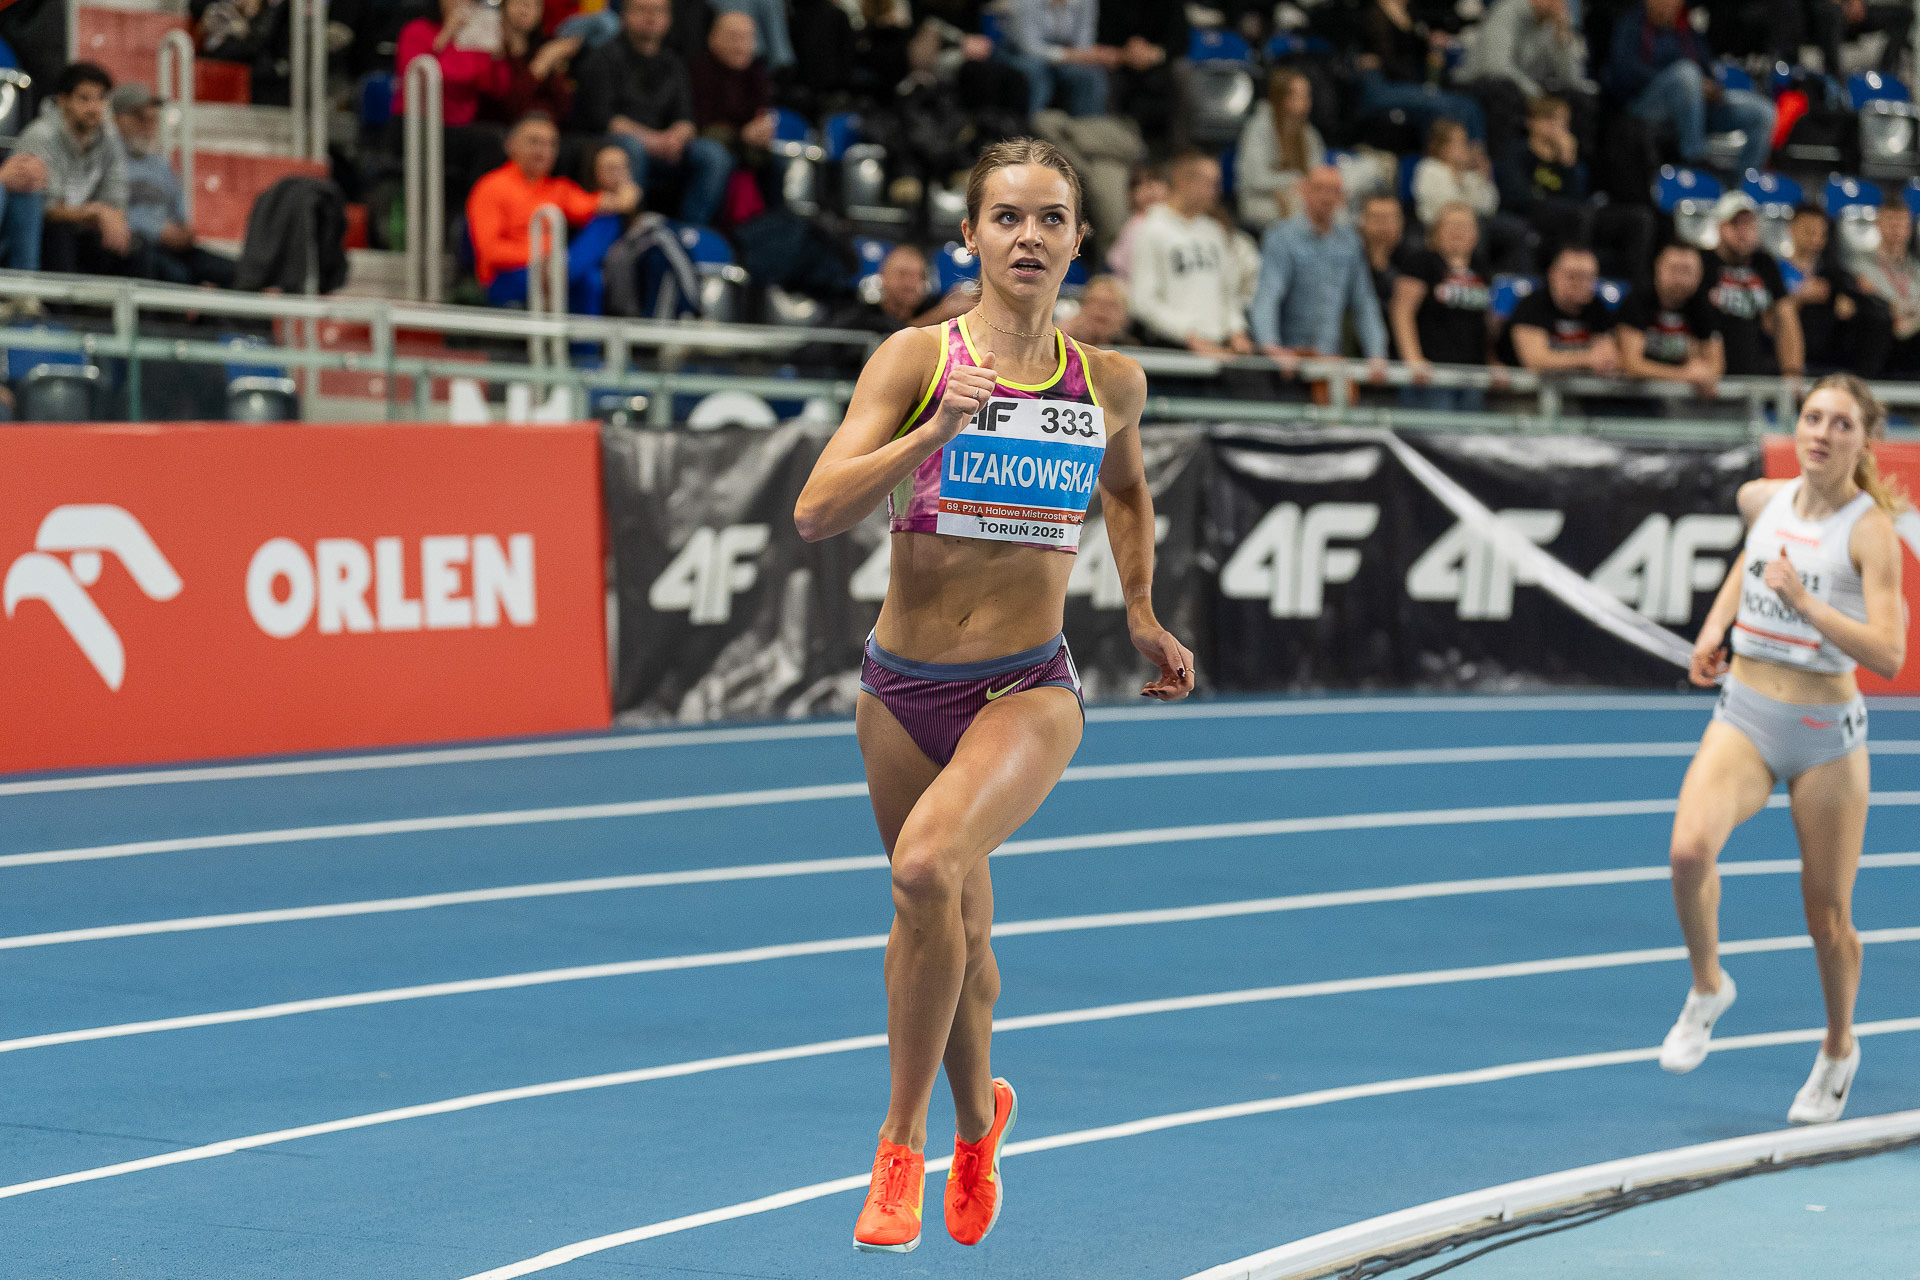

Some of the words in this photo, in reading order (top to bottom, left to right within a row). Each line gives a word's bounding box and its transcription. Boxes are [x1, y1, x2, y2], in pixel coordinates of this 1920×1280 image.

[948, 450, 1095, 494] LIZAKOWSKA
[1041, 407, 1094, 438] 333
[946, 502, 961, 512] 69.
[962, 504, 984, 514] PZLA
[985, 507, 1020, 517] Halowe
[979, 522, 1029, 536] TORUŃ
[1031, 526, 1065, 539] 2025
[1219, 501, 1381, 619] 4F
[245, 533, 538, 639] ORLEN
[649, 523, 771, 626] 4F
[1406, 508, 1566, 621] 4F
[1586, 512, 1744, 625] 4F
